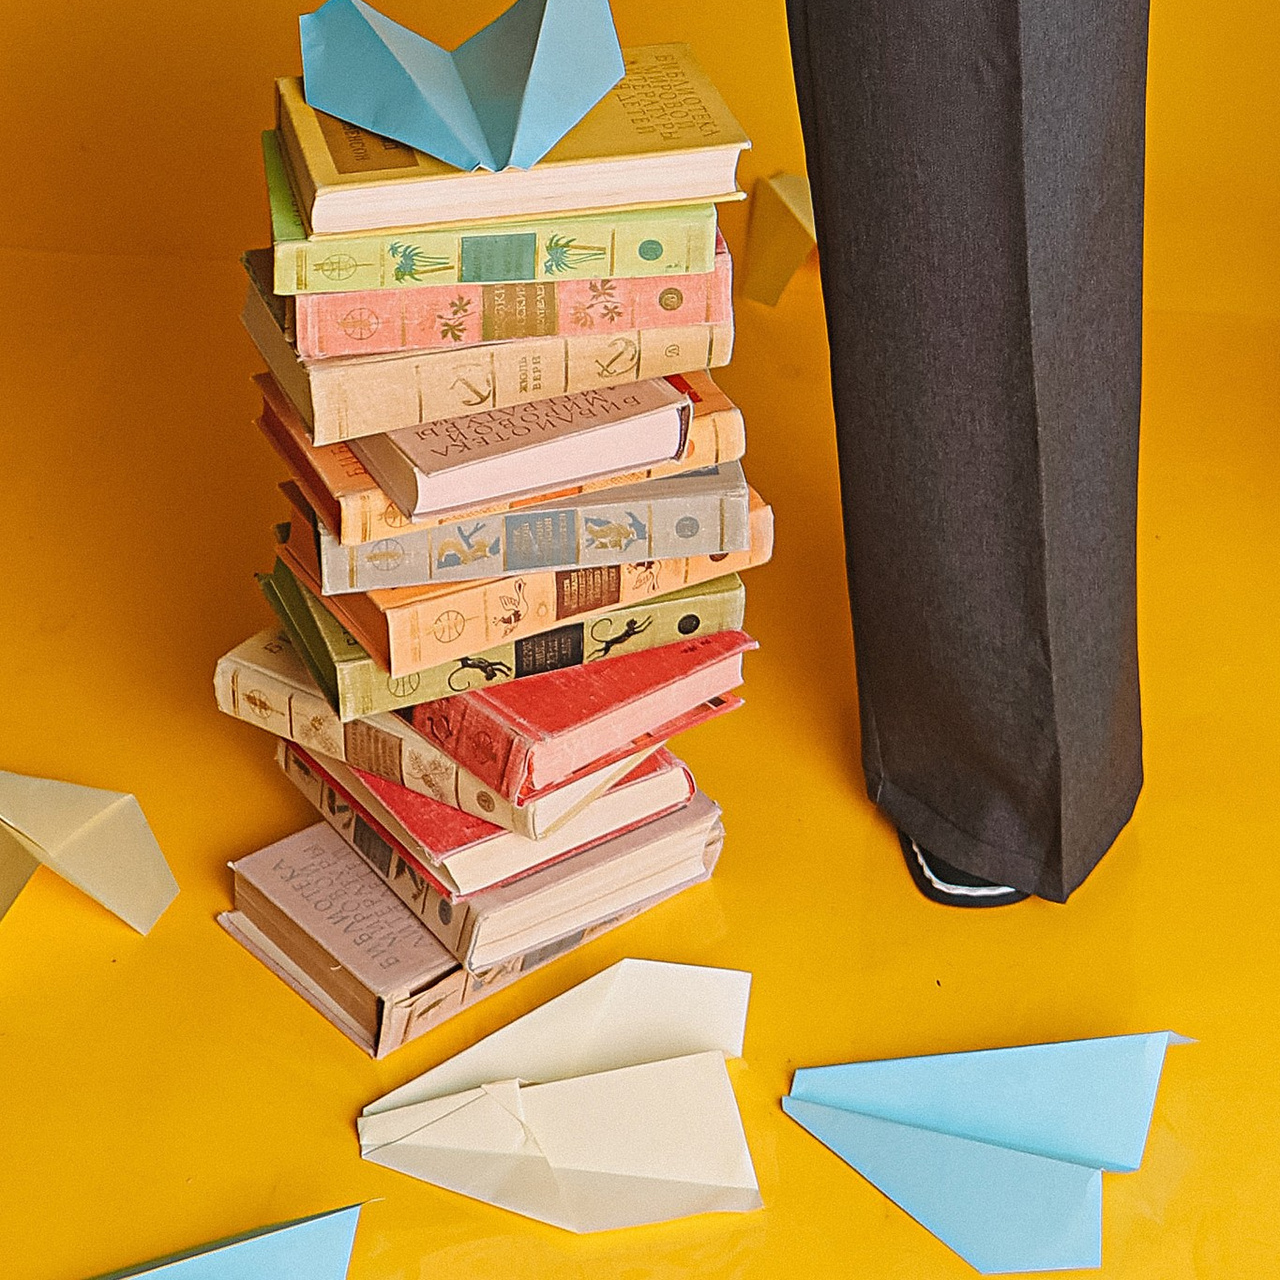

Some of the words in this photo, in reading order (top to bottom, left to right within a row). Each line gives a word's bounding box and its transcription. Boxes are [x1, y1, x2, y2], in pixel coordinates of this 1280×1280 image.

[532, 356, 542, 390] ВЕРН
[430, 394, 641, 458] БИБЛИОТЕКА
[272, 858, 399, 970] БИБЛИОТЕКА
